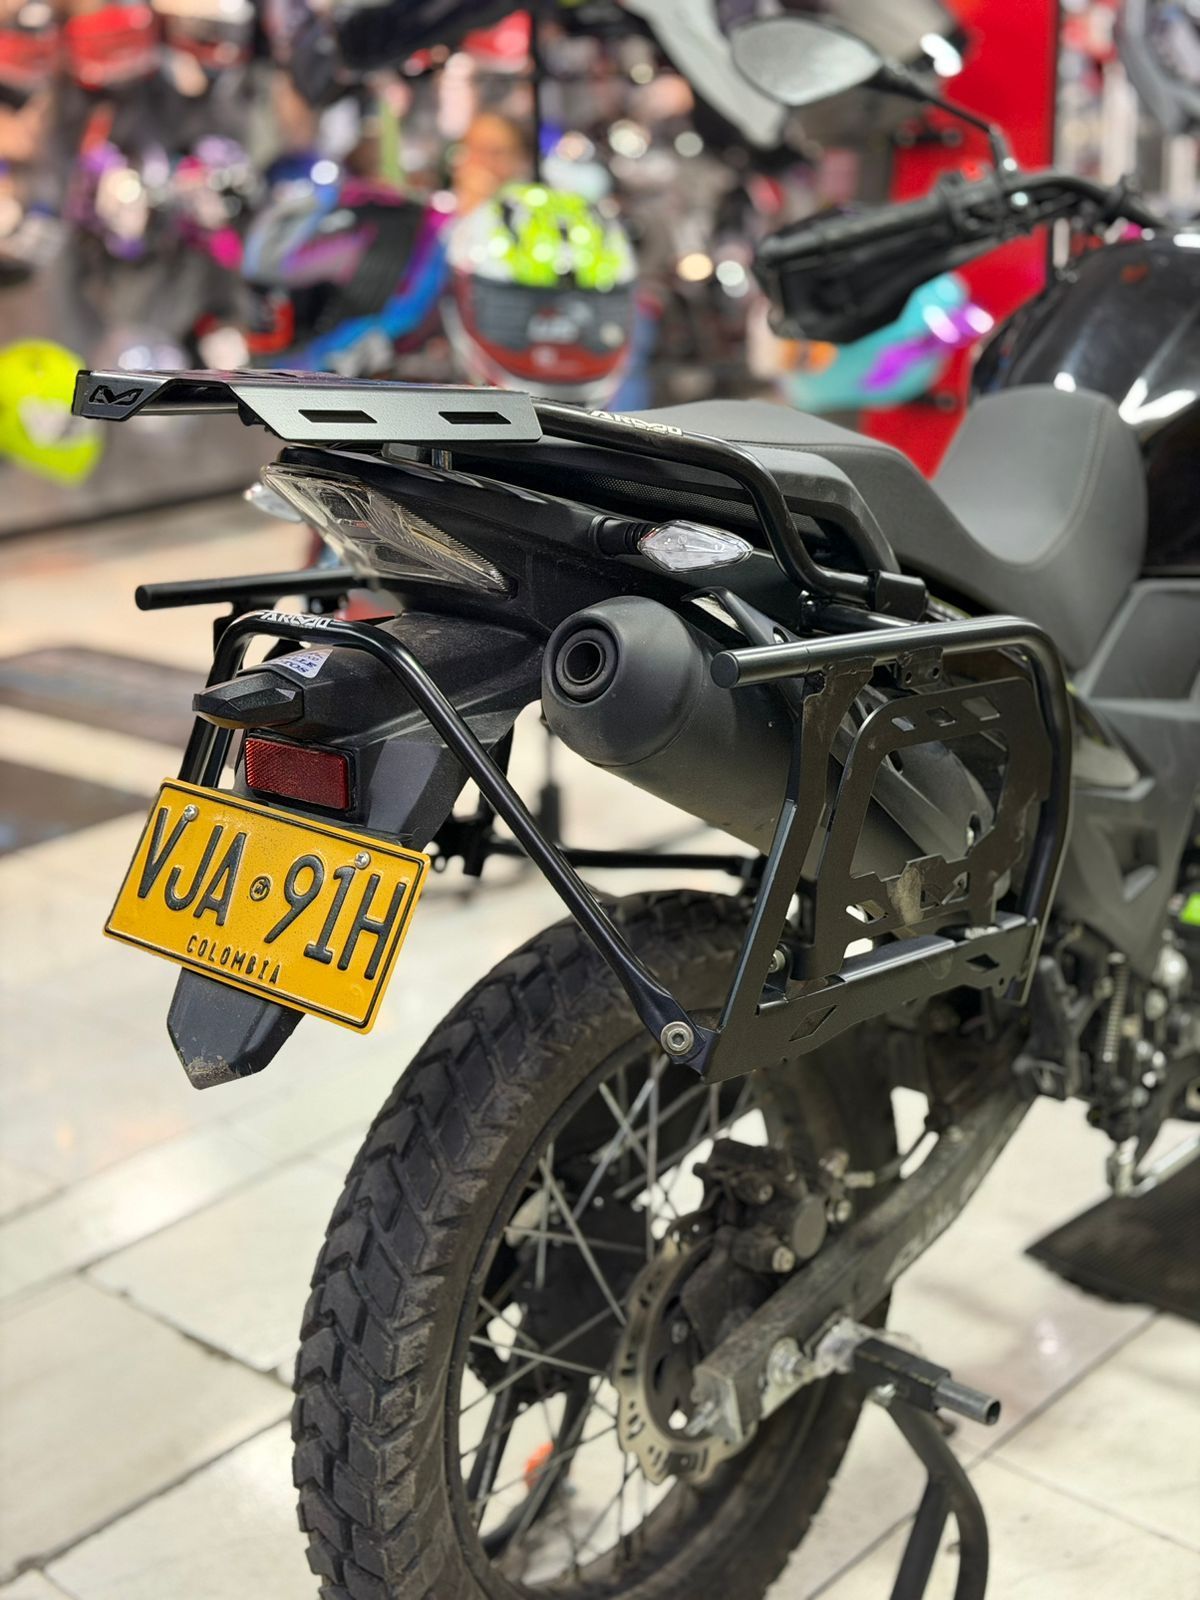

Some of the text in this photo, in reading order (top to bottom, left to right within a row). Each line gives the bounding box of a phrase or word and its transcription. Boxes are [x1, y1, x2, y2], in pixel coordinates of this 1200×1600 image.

[137, 807, 407, 981] VJA 91H
[185, 935, 282, 985] COLOMBIA
